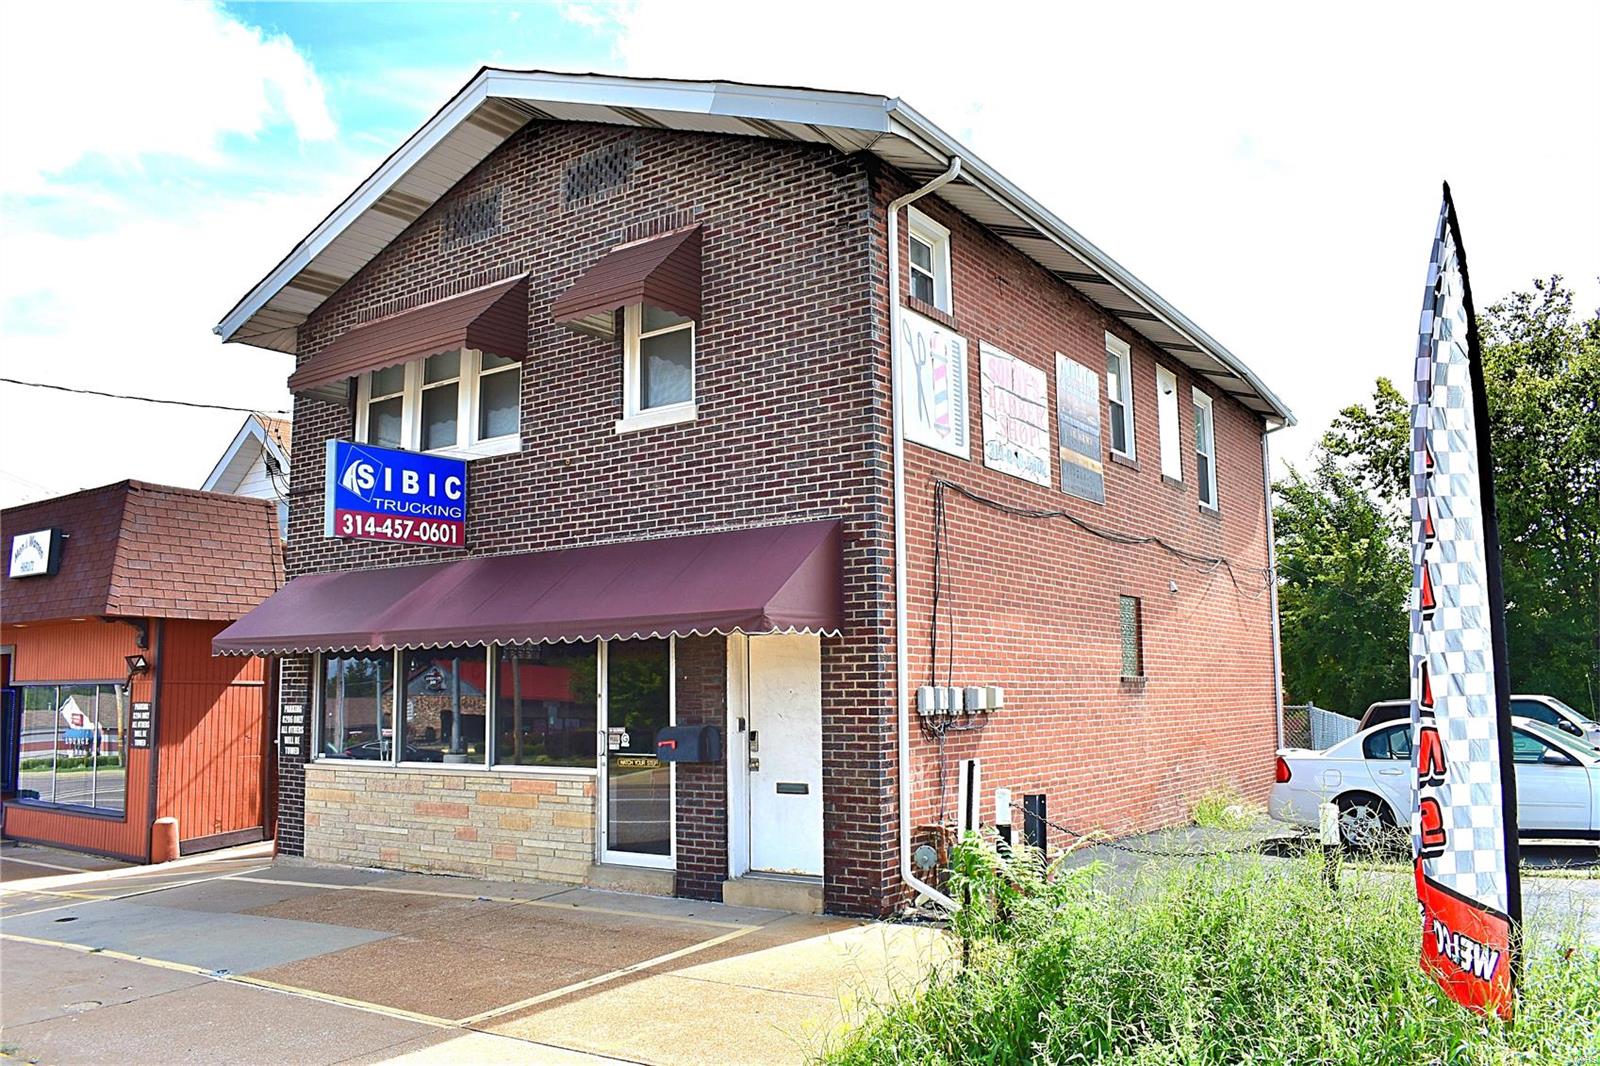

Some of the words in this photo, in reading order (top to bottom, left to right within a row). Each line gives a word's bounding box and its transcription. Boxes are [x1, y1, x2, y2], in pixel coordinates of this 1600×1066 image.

[357, 464, 461, 500] SIBIC
[373, 498, 462, 518] TRUCKING
[343, 513, 457, 543] 314-457-0601
[284, 704, 303, 714] PARKING
[288, 725, 304, 734] OTHERS
[284, 736, 294, 745] WILL
[294, 736, 301, 745] BE
[285, 746, 300, 755] TOWED
